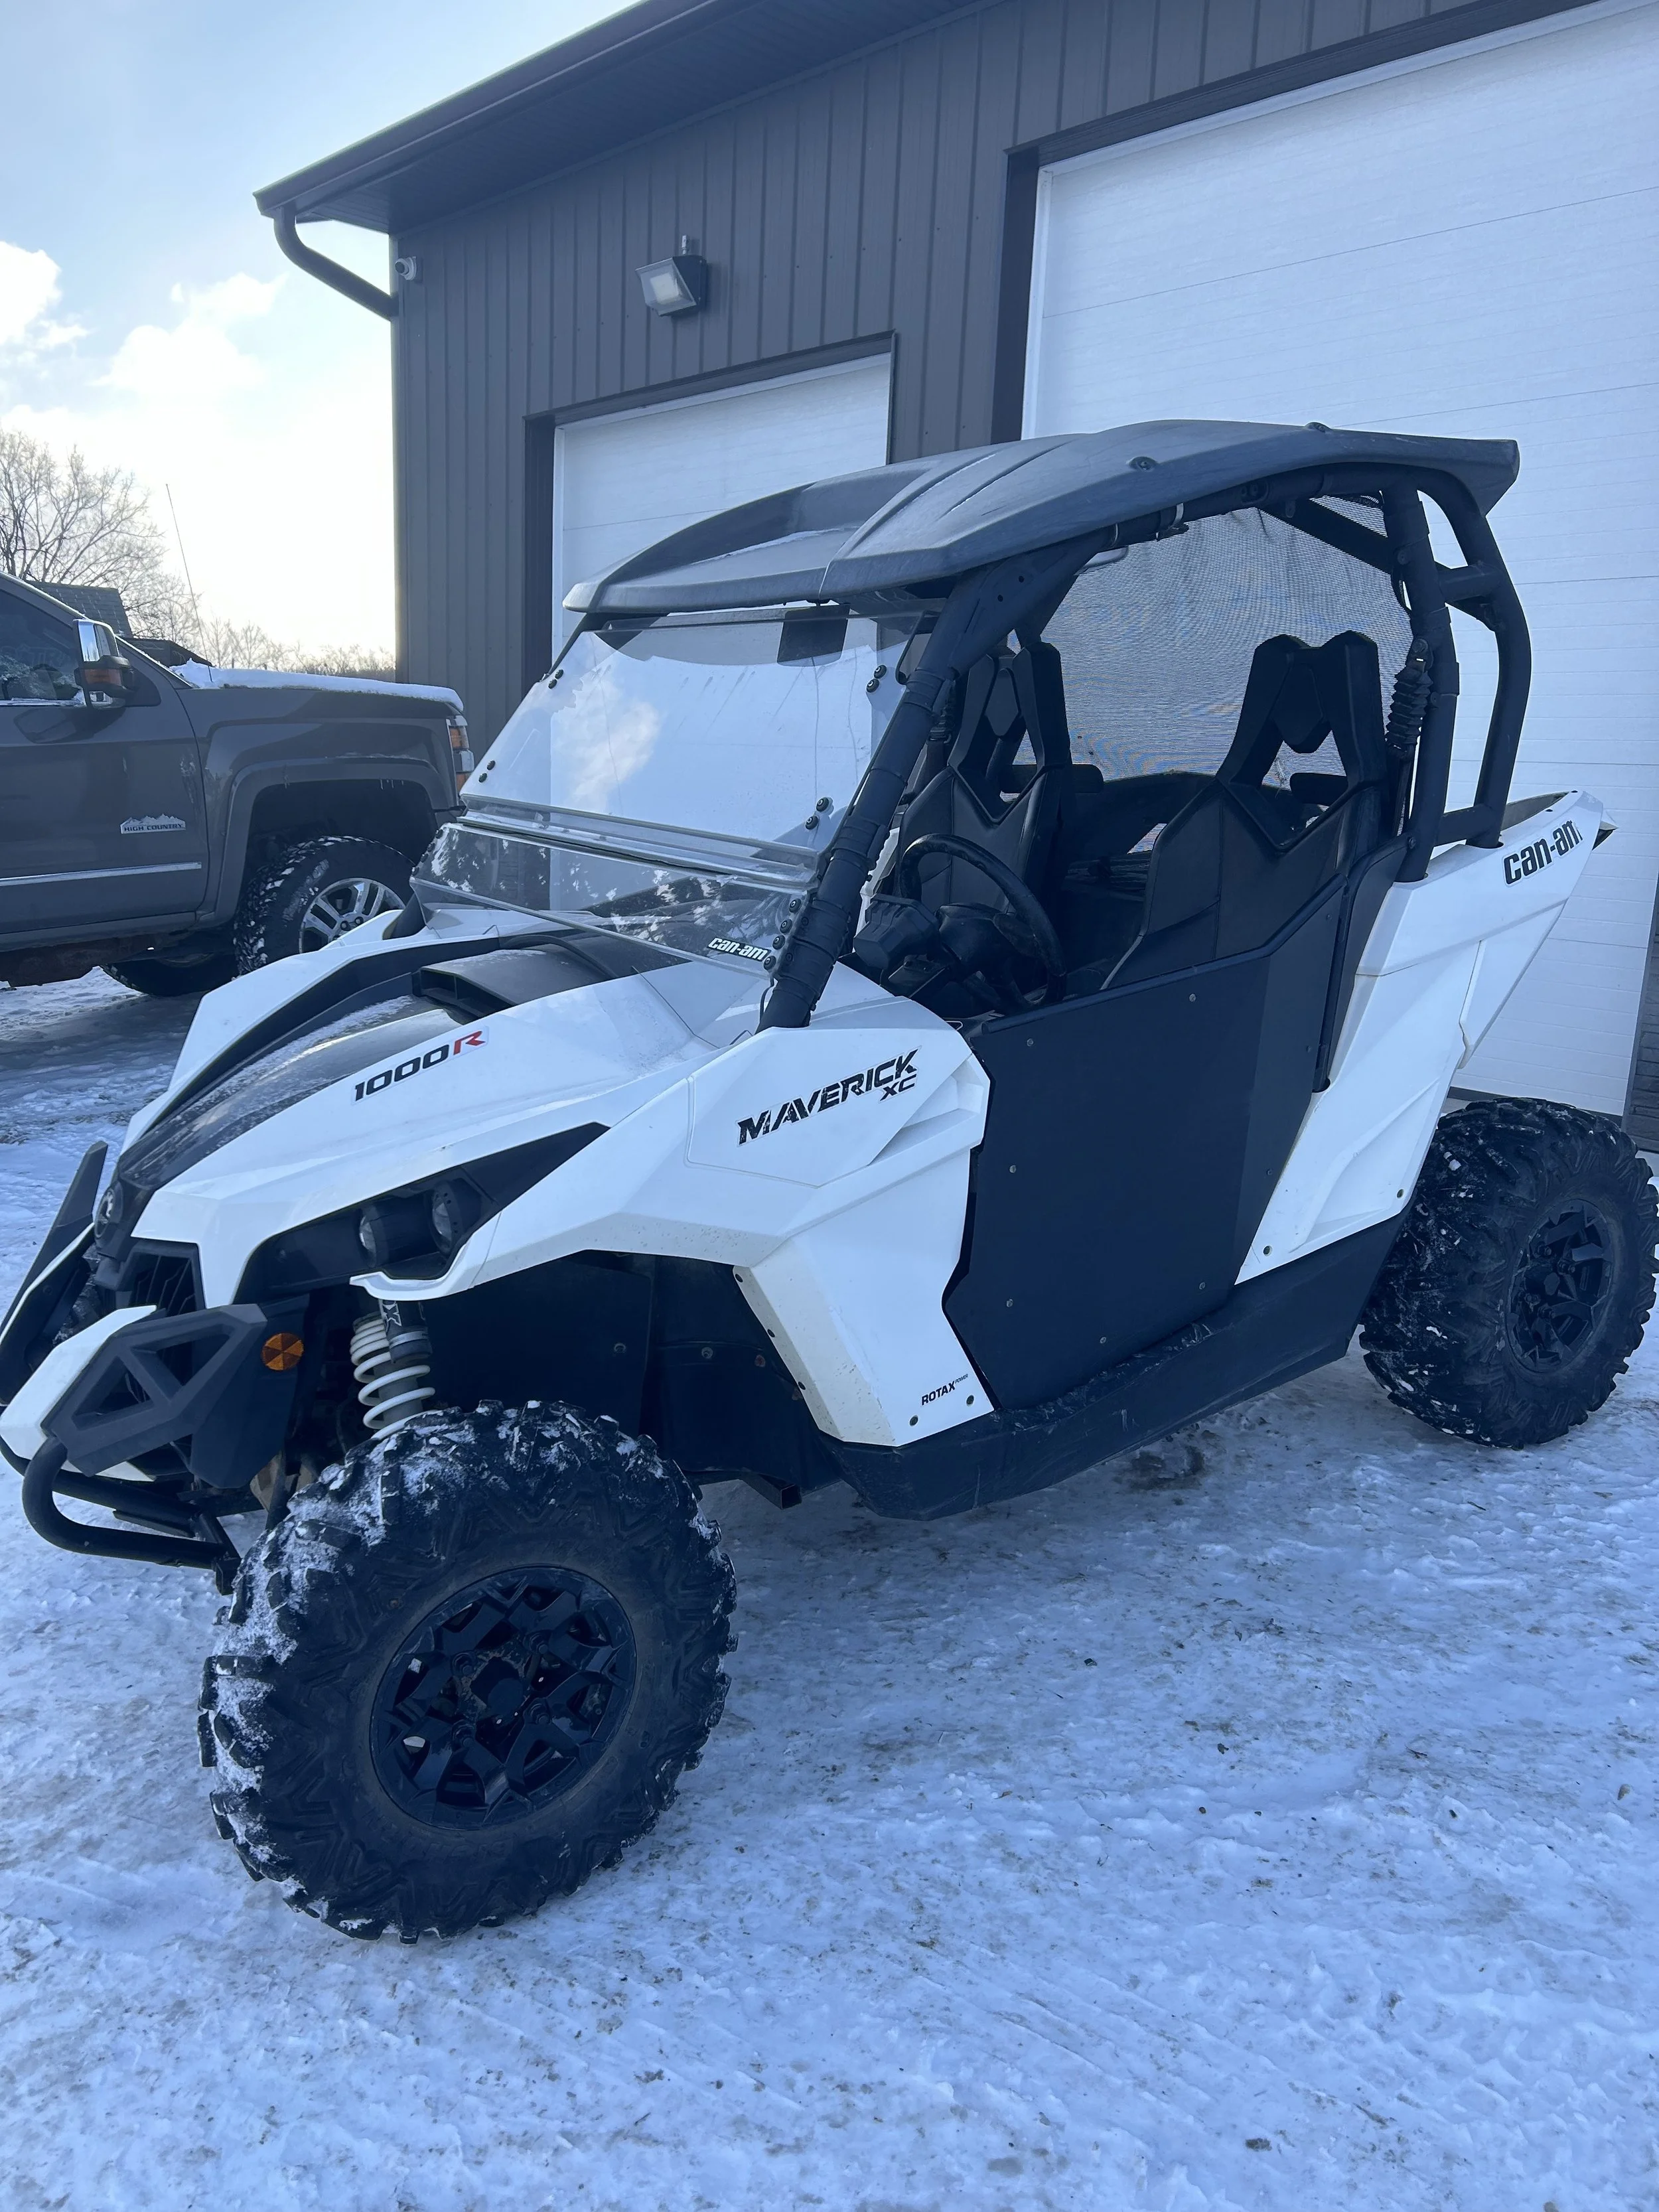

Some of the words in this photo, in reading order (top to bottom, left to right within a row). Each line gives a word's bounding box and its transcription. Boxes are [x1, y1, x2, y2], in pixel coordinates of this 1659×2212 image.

[355, 1031, 486, 1102] 1000R
[880, 1073, 917, 1102] XC
[737, 1048, 918, 1145] MAVERICK
[921, 1380, 956, 1406] ROTAX
[955, 1373, 969, 1384] POWER
